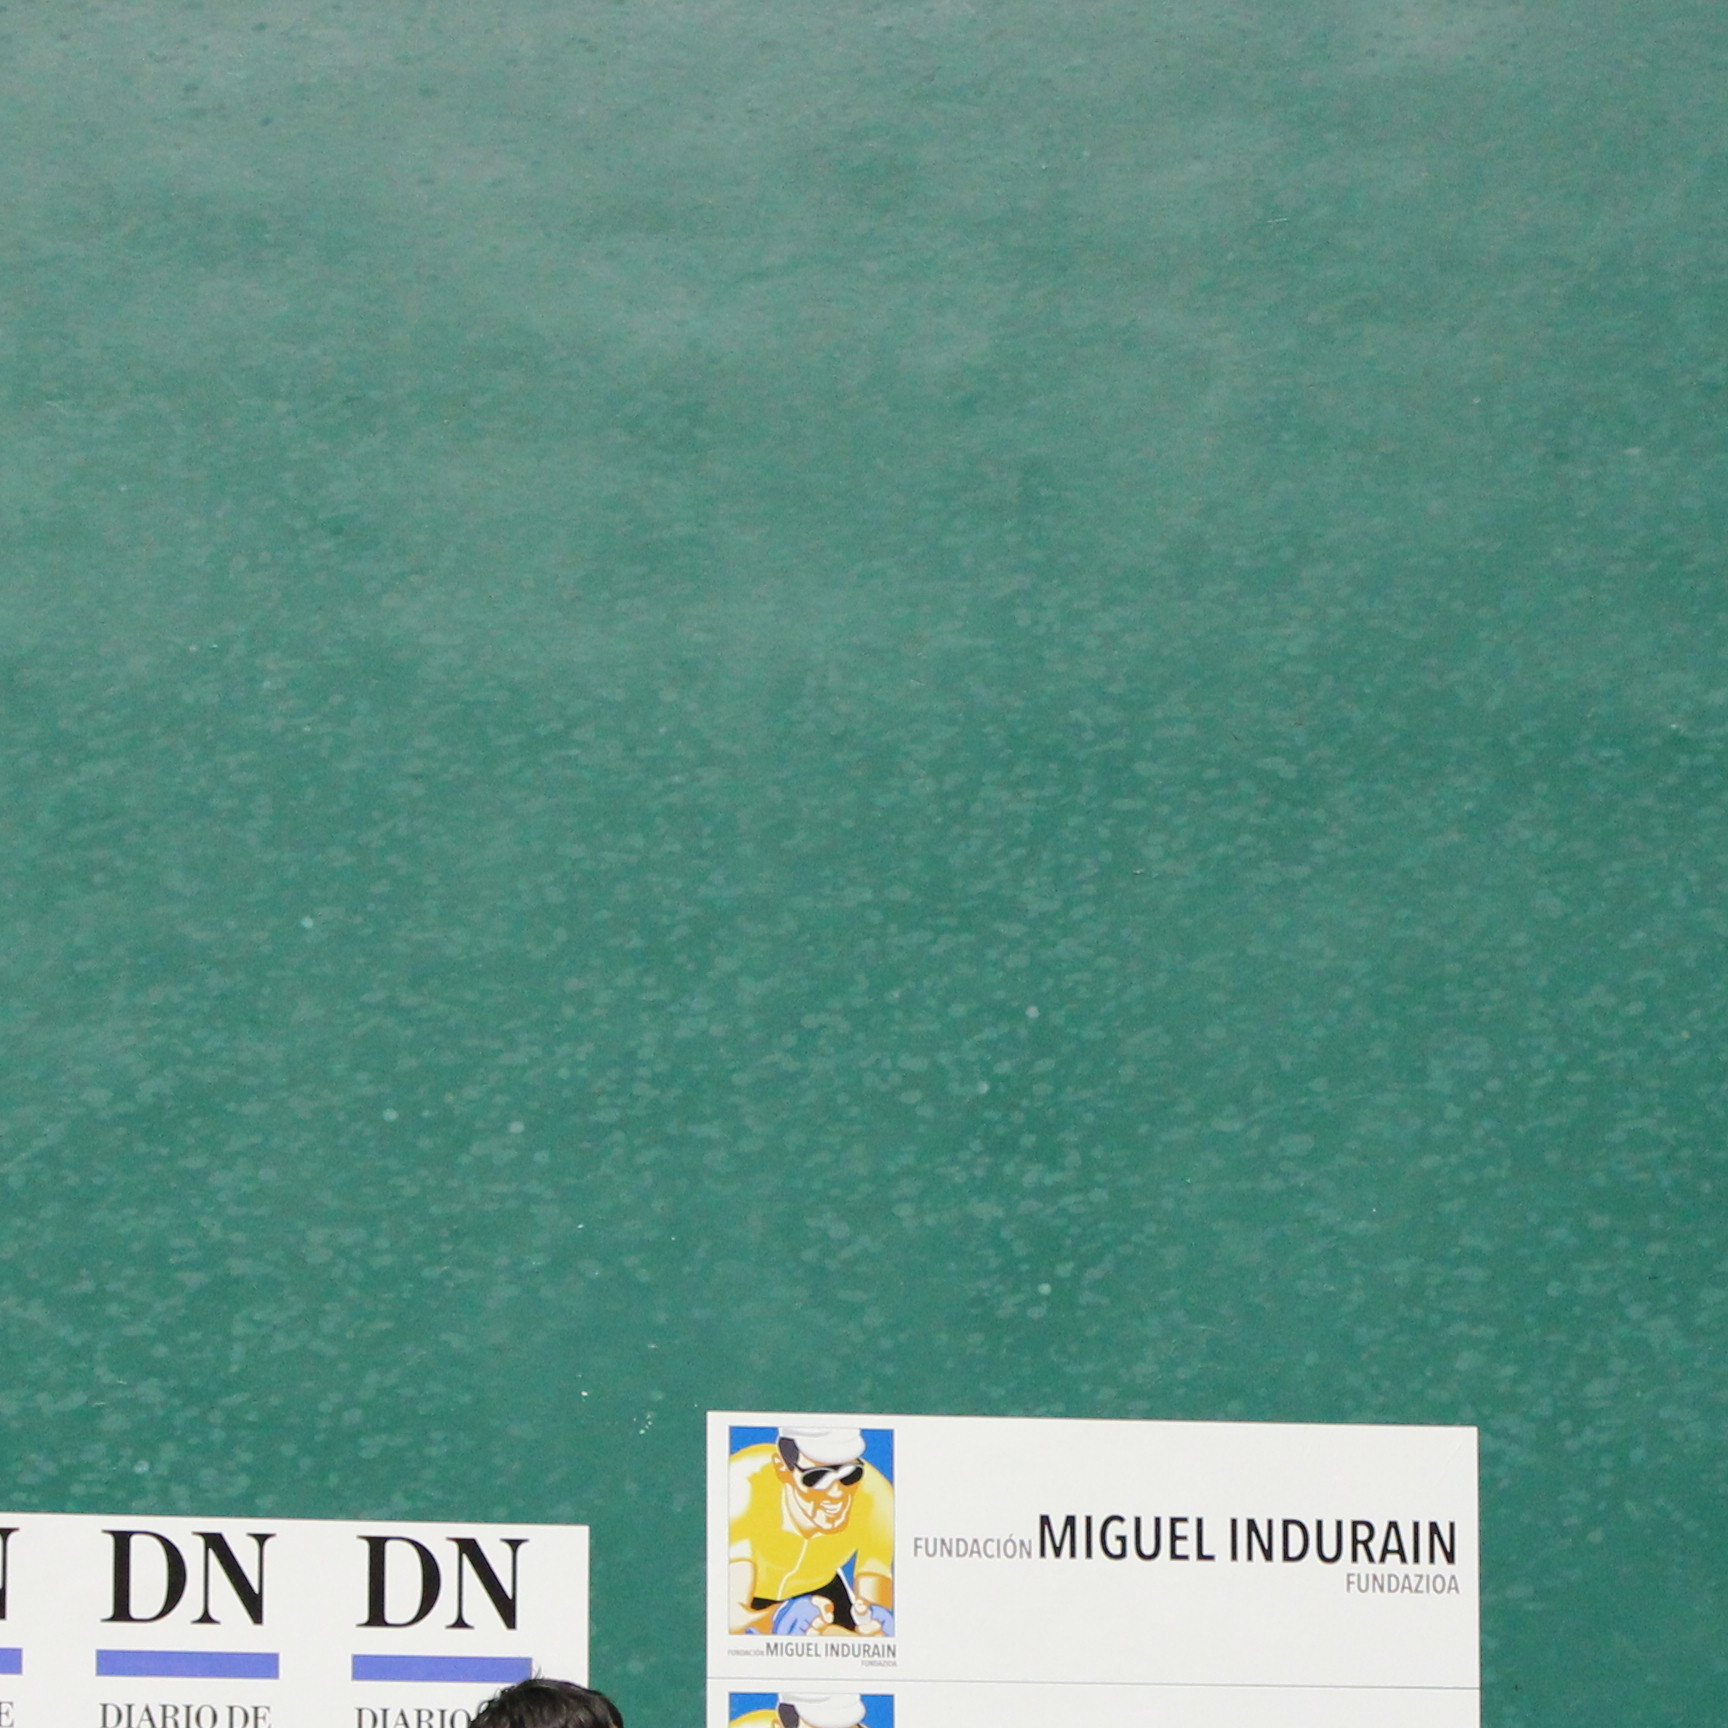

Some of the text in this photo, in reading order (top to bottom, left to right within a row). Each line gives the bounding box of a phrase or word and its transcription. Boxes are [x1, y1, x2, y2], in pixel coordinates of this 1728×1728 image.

[914, 1515, 1455, 1564] FUNDACIÓN MIGUEL INDURAIN
[101, 1530, 276, 1625] DN
[357, 1536, 528, 1630] DN
[1347, 1573, 1459, 1594] FUNDAZIOA
[766, 1642, 821, 1657] MIGUEL
[825, 1643, 896, 1658] INDURAIN
